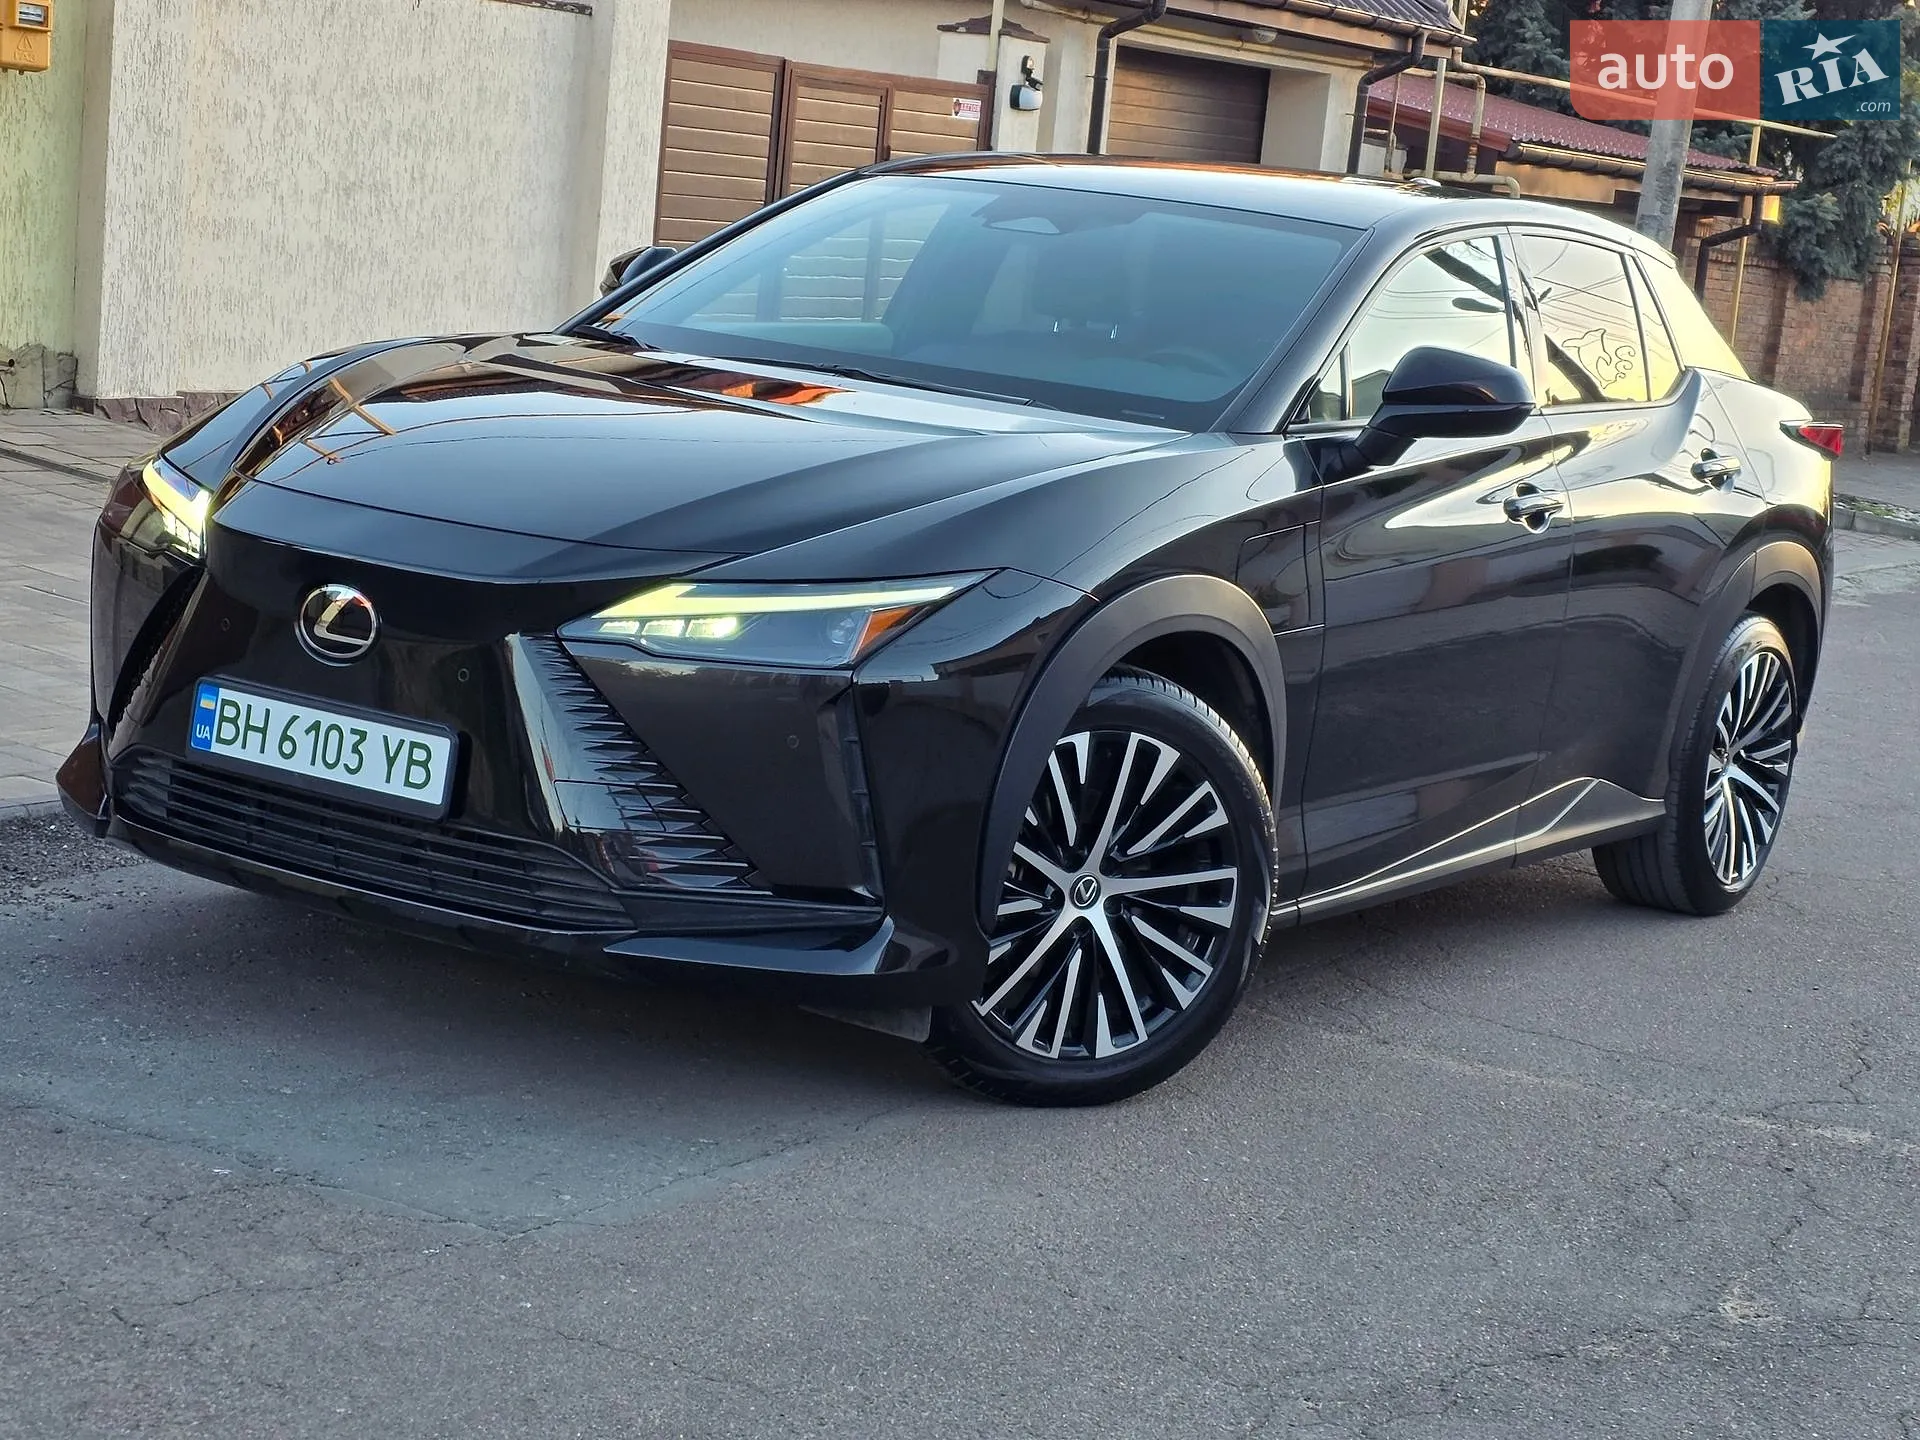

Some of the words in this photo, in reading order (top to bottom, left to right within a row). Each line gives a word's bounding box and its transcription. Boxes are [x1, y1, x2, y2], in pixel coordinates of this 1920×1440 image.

[195, 723, 211, 740] UA
[215, 698, 271, 754] BH
[277, 714, 368, 775] 6103
[382, 734, 433, 790] YB
